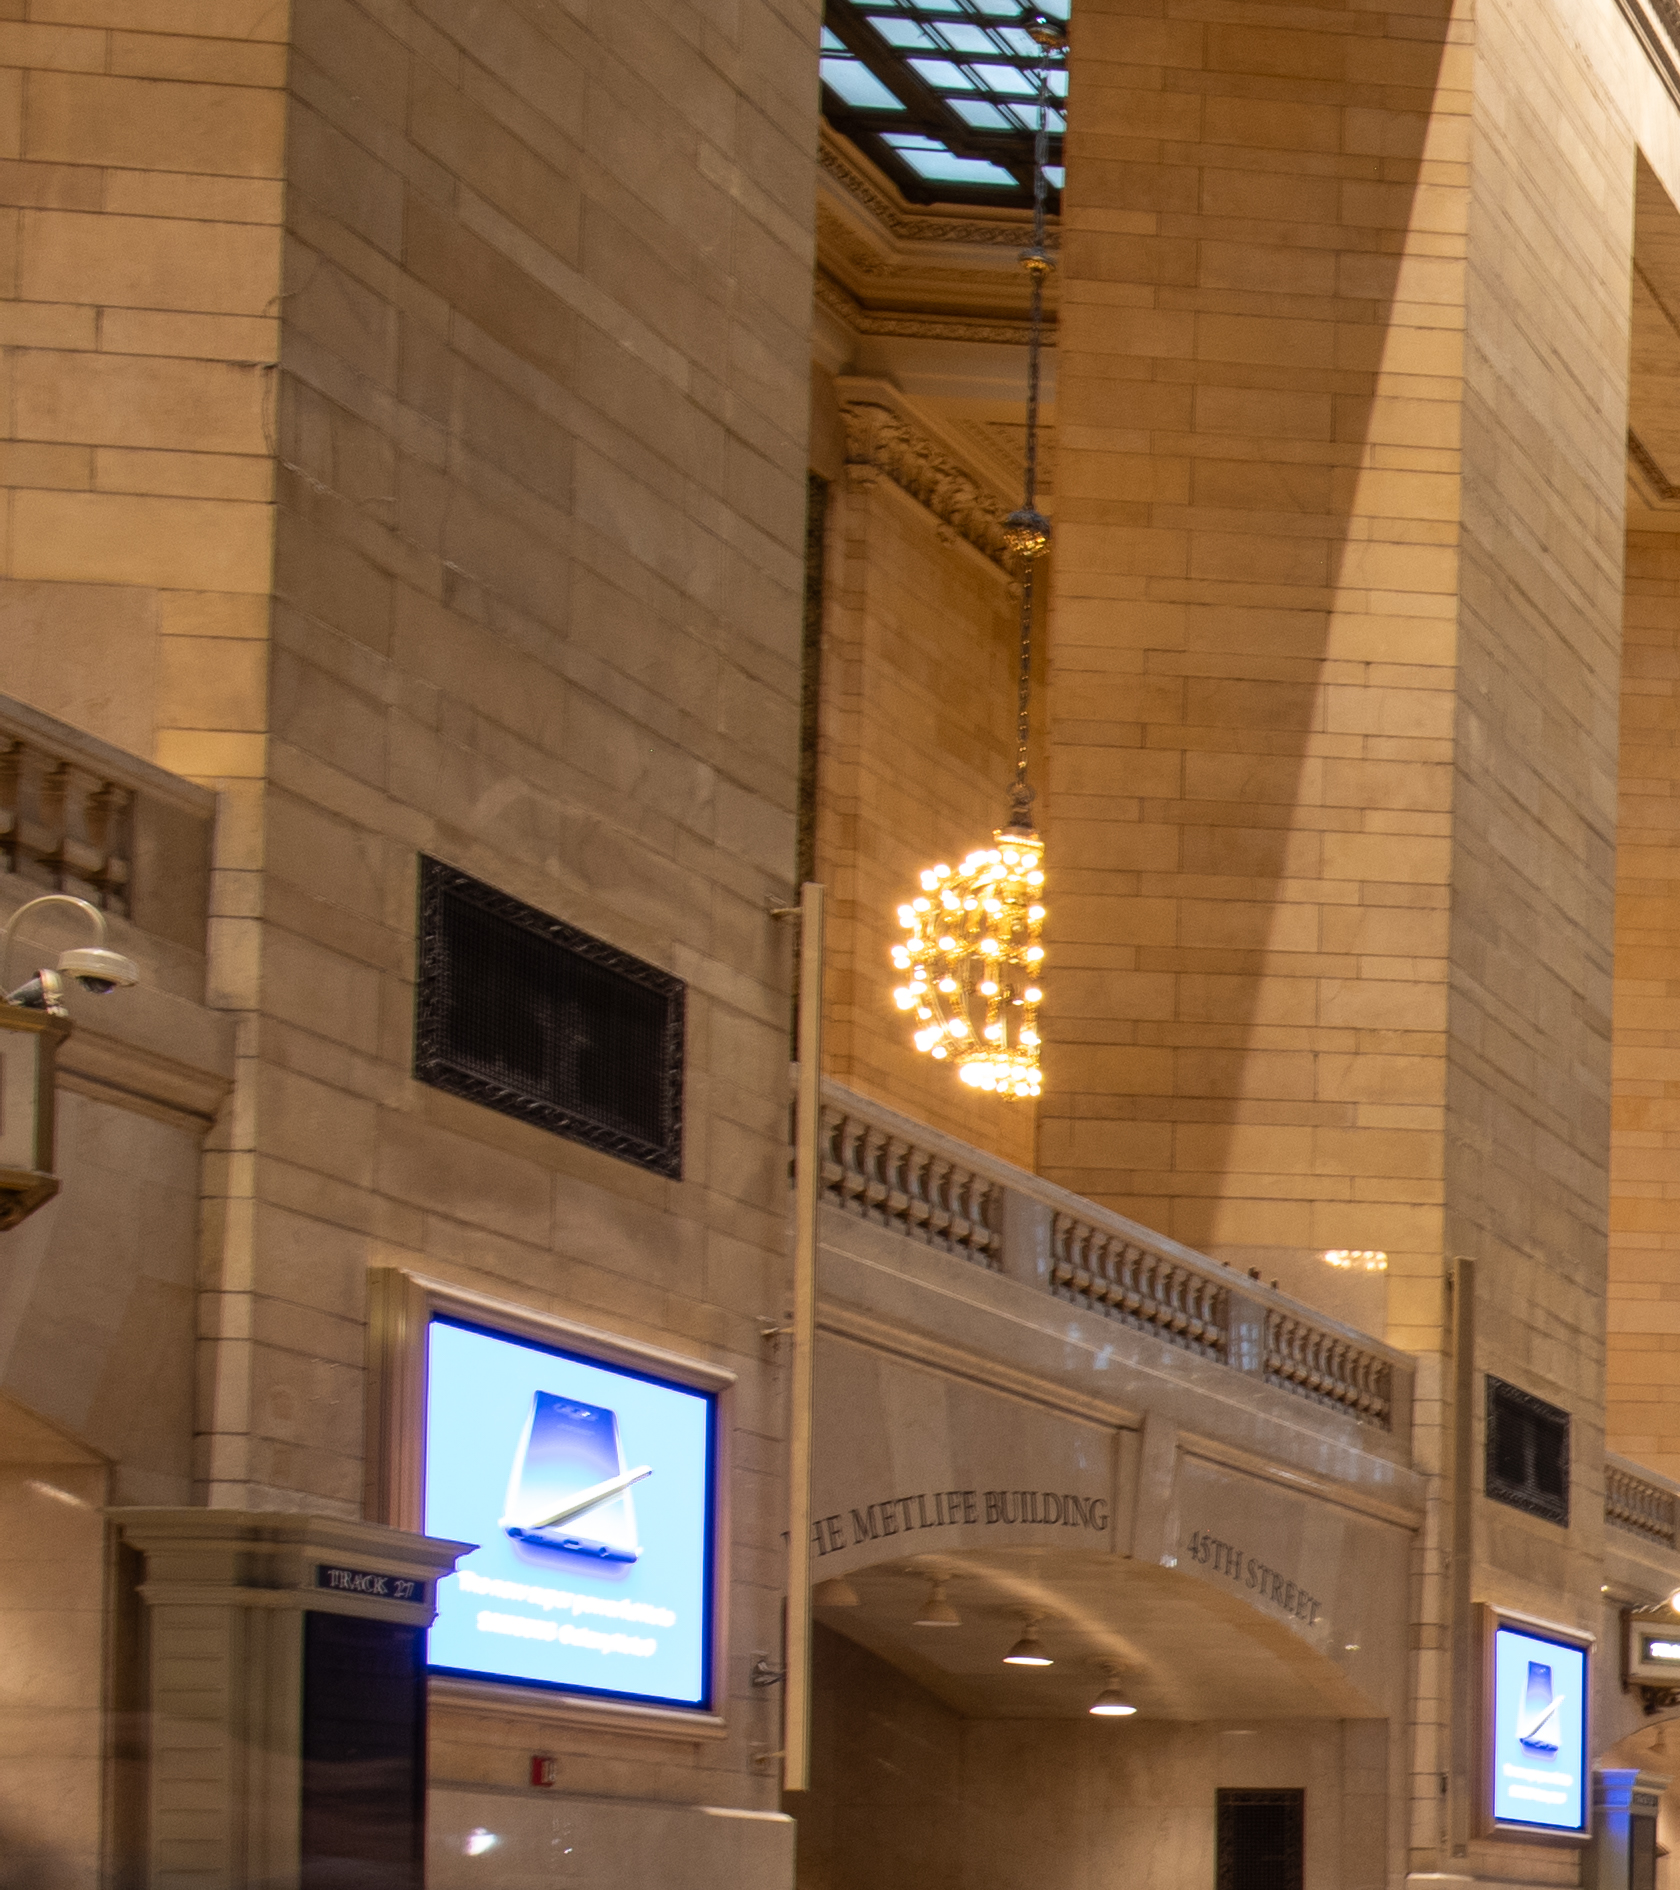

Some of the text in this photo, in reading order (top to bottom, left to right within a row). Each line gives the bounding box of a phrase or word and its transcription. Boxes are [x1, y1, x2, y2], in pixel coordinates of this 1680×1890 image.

[850, 1490, 977, 1545] METLIFE
[986, 1490, 1110, 1532] BUILDING
[328, 1569, 414, 1598] TRACK 27
[1188, 1531, 1321, 1626] 45TH STREET
